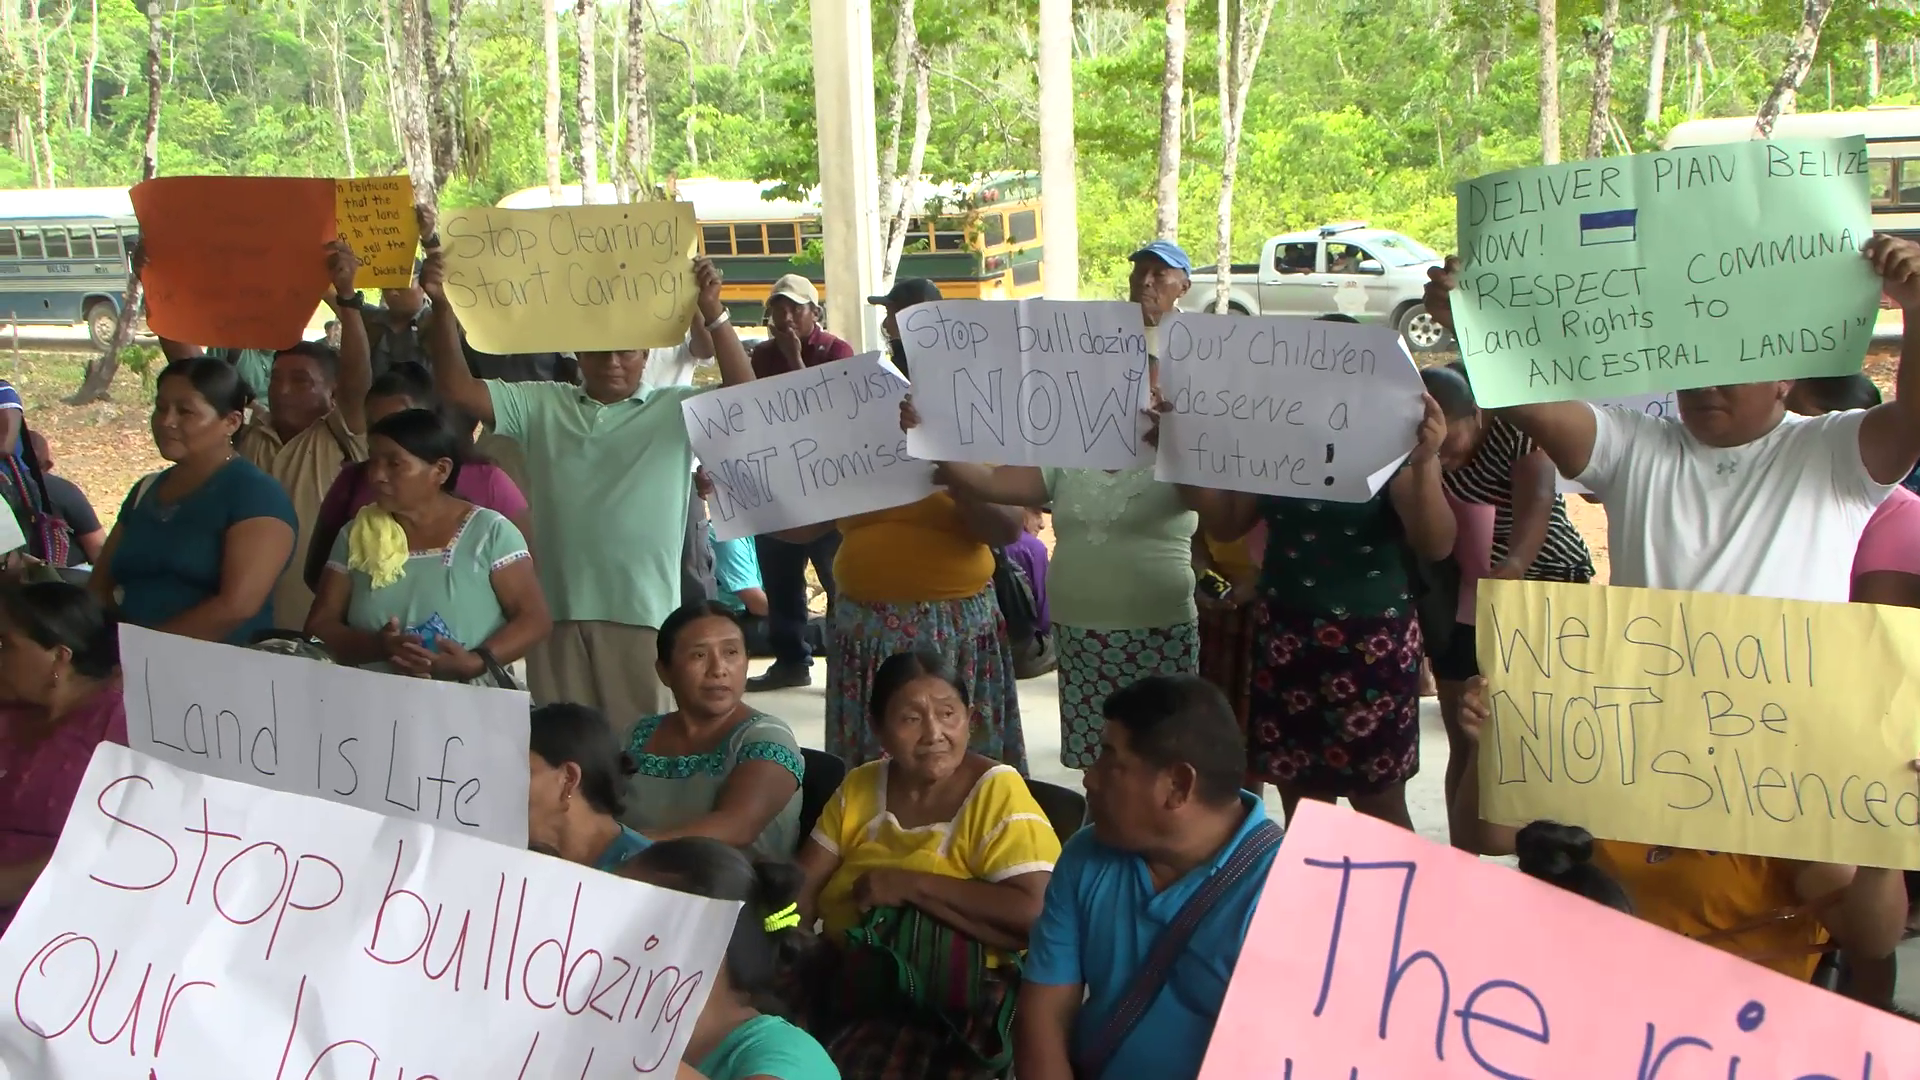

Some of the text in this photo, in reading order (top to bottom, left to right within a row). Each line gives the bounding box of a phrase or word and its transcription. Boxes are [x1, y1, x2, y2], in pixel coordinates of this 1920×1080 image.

[344, 194, 391, 209] that the
[376, 208, 400, 221] land
[1469, 167, 1621, 227] DELIVER
[1766, 144, 1869, 178] BELIZE
[353, 226, 363, 239] to
[369, 225, 401, 236] them
[363, 240, 406, 254] sell the
[447, 212, 679, 264] Stop Clearing!
[1465, 224, 1544, 271] NOW!
[447, 262, 685, 323] Start Caring!
[1465, 293, 1729, 357] Land Rights to
[906, 305, 1147, 382] Stop bulldozing
[1168, 320, 1237, 362] Our
[1528, 318, 1869, 388] ANCESTRAL LANDS!"
[689, 398, 747, 440] We
[755, 368, 835, 426] want
[953, 367, 1143, 457] NOW
[1174, 375, 1349, 431] deserve a
[707, 437, 918, 522] NOT Promise
[1491, 596, 1595, 679] We
[145, 657, 278, 776] Land
[385, 719, 481, 827] Life
[1491, 686, 1788, 786] NOT Be
[89, 774, 344, 961] Stop
[364, 839, 704, 1073] bulldozing
[1304, 855, 1550, 1080] The
